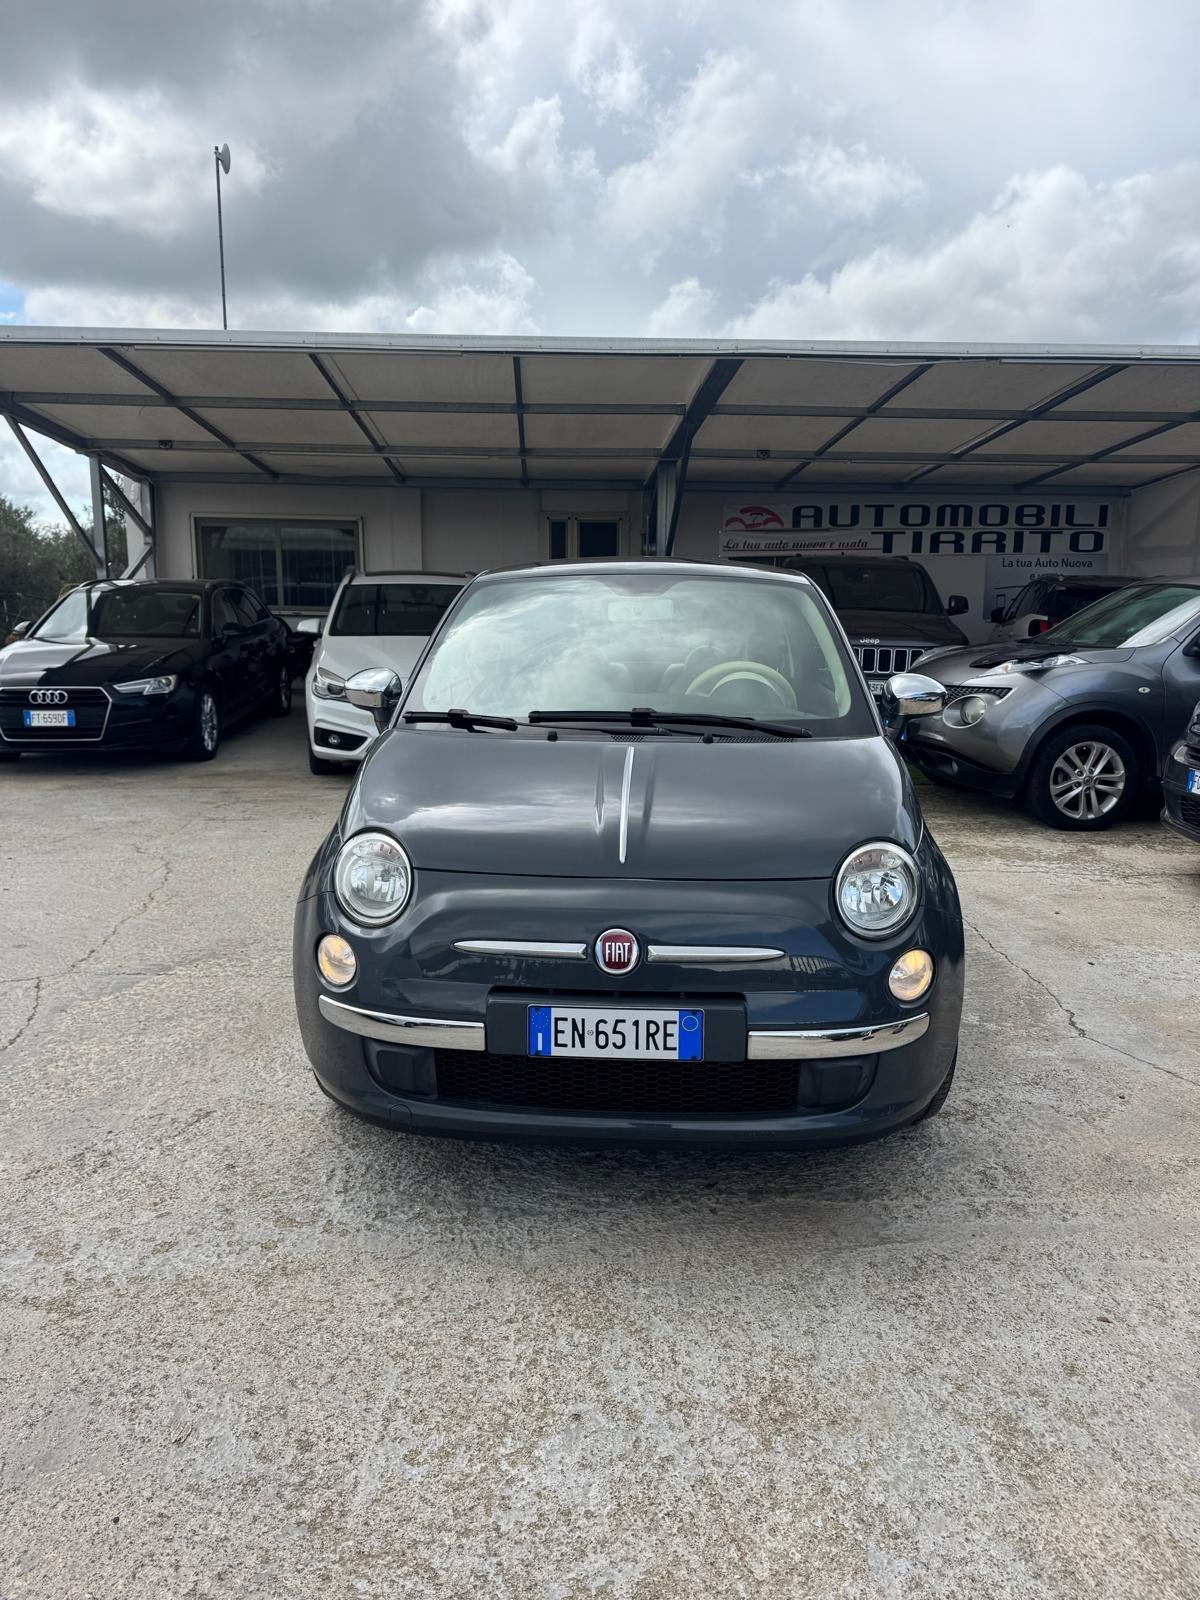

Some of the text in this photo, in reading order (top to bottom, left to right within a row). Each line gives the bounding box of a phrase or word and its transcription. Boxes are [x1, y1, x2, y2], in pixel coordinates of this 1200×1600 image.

[791, 504, 1109, 529] AUTOMOBILI
[722, 538, 740, 550] La
[742, 539, 761, 549] tua
[764, 539, 789, 549] auto
[792, 541, 827, 549] nuova
[838, 539, 869, 549] usata
[870, 531, 1105, 554] TIRRITO
[1002, 557, 1093, 568] La tua Auto Nuova
[859, 636, 880, 645] Jeep
[605, 942, 631, 963] FIAT
